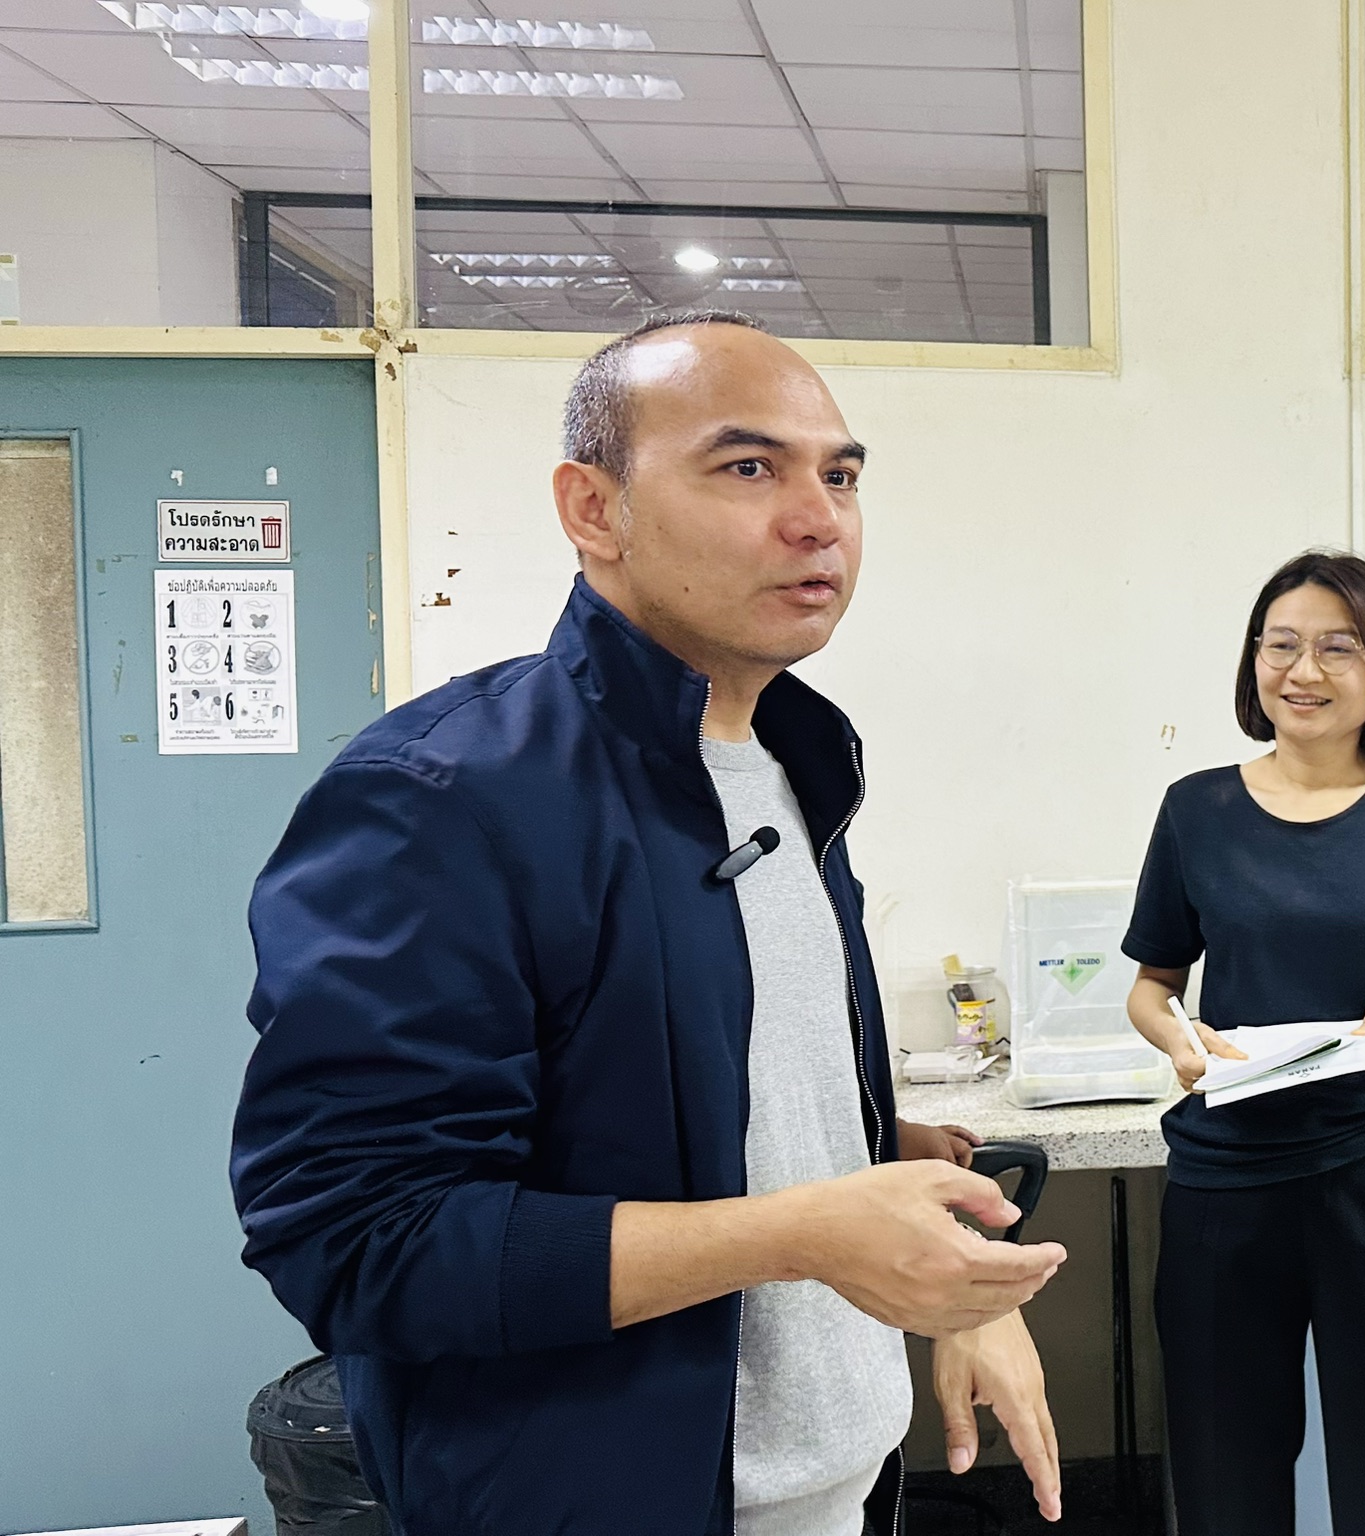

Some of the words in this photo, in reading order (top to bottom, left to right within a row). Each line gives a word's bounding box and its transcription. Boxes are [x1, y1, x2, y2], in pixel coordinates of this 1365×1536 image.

[168, 509, 255, 527] โปรดรักษา
[165, 537, 259, 551] ความสะอาด
[167, 600, 176, 628] 1
[222, 599, 232, 628] 2
[168, 645, 177, 673] 3
[224, 645, 233, 673] 4
[169, 693, 178, 720] 5
[225, 692, 234, 720] 6
